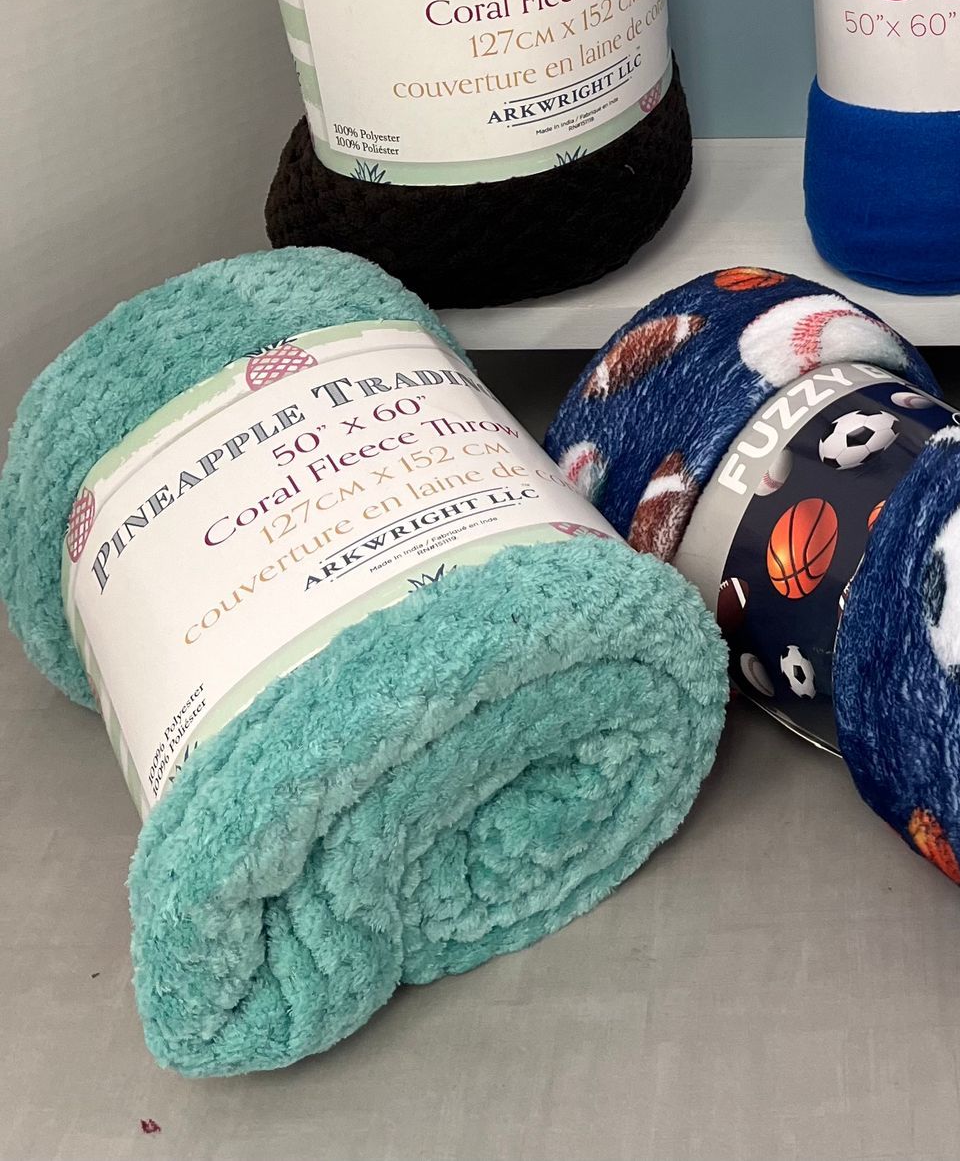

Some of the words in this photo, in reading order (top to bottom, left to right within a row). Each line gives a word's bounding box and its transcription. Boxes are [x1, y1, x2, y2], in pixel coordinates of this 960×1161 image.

[393, 68, 537, 99] couverture
[546, 57, 574, 78] en
[580, 34, 622, 67] laine
[626, 17, 643, 42] de
[487, 72, 614, 124] ARKWRIGHT
[619, 54, 642, 80] LLC
[334, 124, 358, 138] 100%
[360, 129, 400, 143] Polyester
[336, 136, 360, 150] 100%
[362, 142, 399, 155] Poliéster
[536, 125, 552, 135] Made
[561, 118, 575, 128] India
[398, 446, 455, 473] 152
[718, 367, 853, 495] FUZZY
[90, 405, 306, 595] PINEAPPLE
[204, 483, 301, 548] Coral
[306, 432, 420, 483] Fleece
[421, 417, 519, 439] Throw
[183, 517, 353, 646] couverture
[362, 496, 402, 520] en
[405, 469, 484, 500] laine
[492, 461, 529, 478] de
[304, 497, 478, 591] ARKWRIGHT
[490, 488, 540, 504] LLC
[369, 558, 392, 573] Made
[403, 542, 424, 556] India
[479, 516, 498, 525] Inde
[148, 743, 165, 785] 100%
[164, 683, 205, 741] Polyester
[152, 753, 170, 797] 100%
[169, 698, 206, 753] Poliéster
